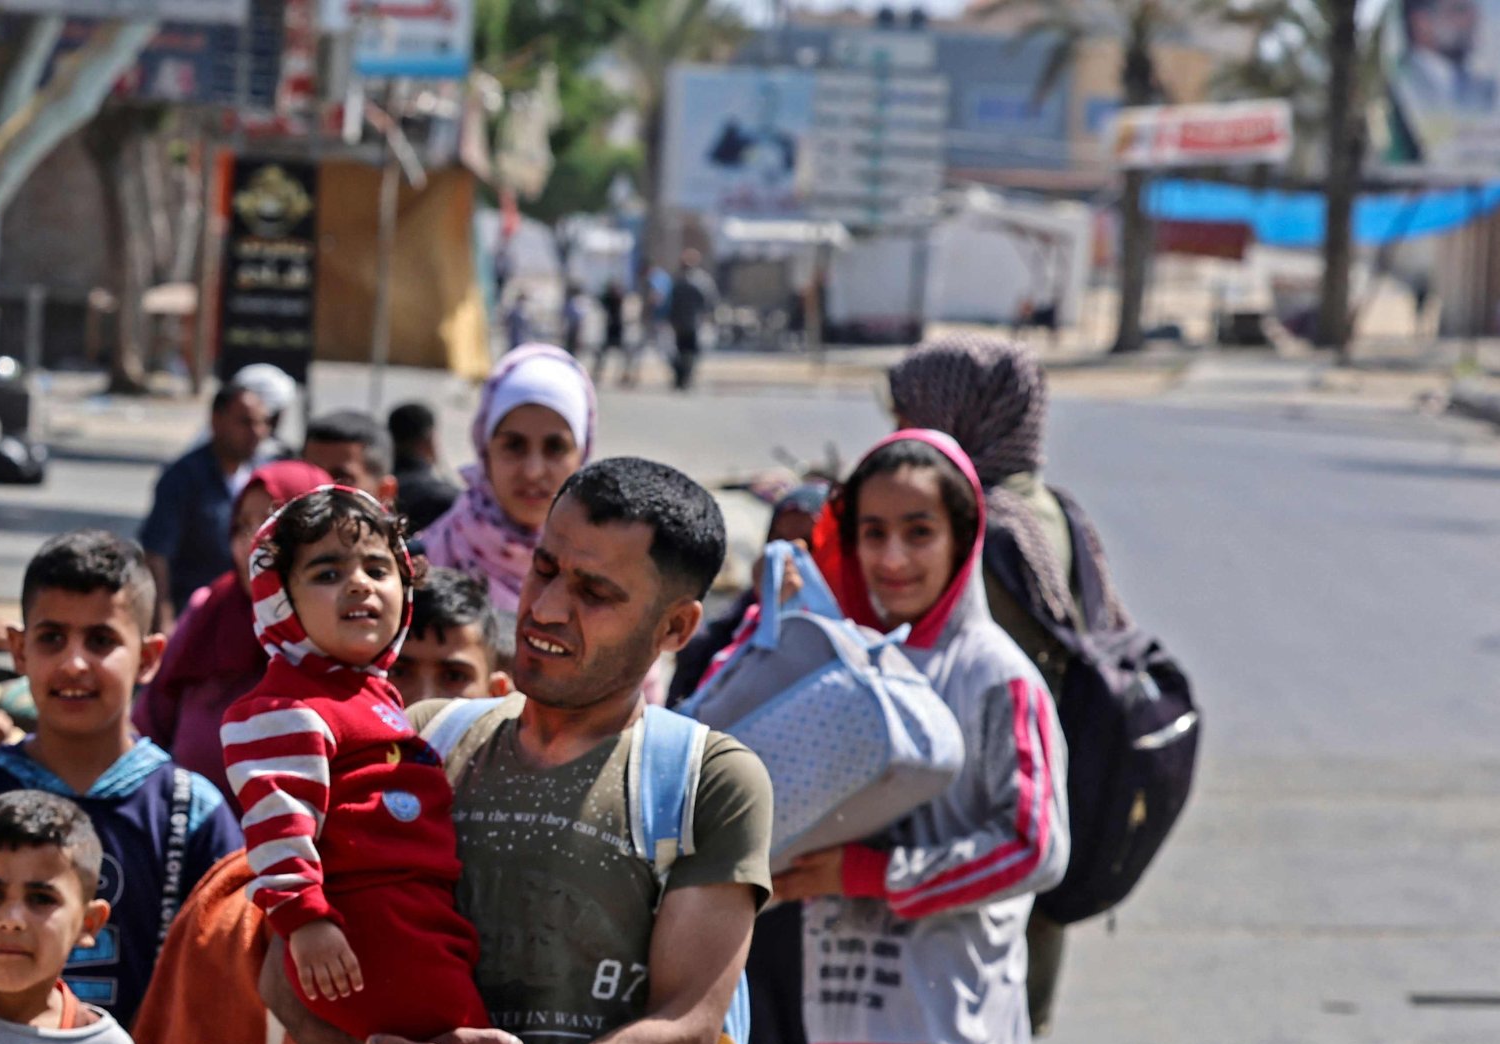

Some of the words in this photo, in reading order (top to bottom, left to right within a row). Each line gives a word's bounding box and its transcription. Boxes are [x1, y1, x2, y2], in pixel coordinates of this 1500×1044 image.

[470, 809, 485, 822] in
[487, 809, 510, 823] the
[513, 811, 540, 826] way
[540, 812, 571, 831] they
[572, 820, 599, 838] can
[165, 851, 182, 892] LOVE
[554, 1011, 605, 1030] WANT
